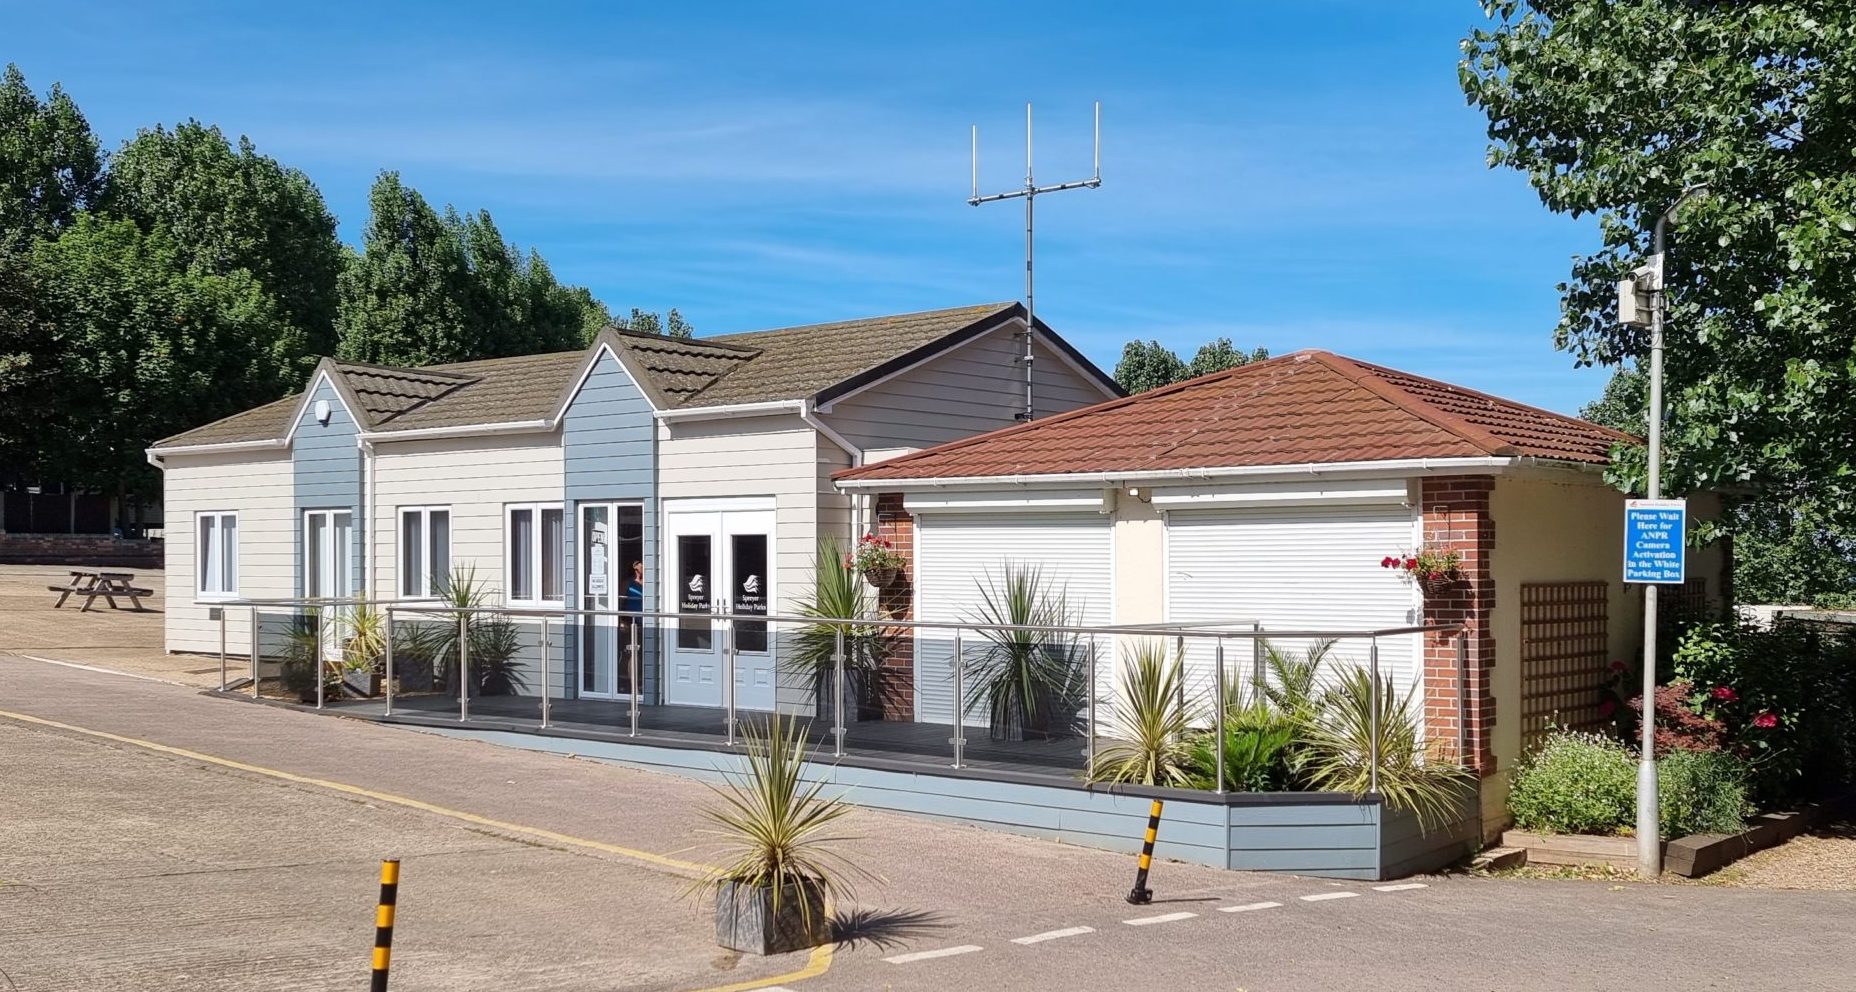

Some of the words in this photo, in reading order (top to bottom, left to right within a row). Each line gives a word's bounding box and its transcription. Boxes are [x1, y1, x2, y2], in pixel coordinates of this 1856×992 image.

[1631, 512, 1657, 520] Please
[1659, 512, 1680, 520] Wait
[1637, 522, 1658, 530] Here
[1660, 522, 1672, 530] for
[1641, 531, 1669, 540] ANPR
[1636, 541, 1670, 549] Camera
[1633, 551, 1676, 559] Activation
[1654, 561, 1680, 569] White
[1628, 569, 1661, 579] Parking
[1664, 570, 1680, 578] Box
